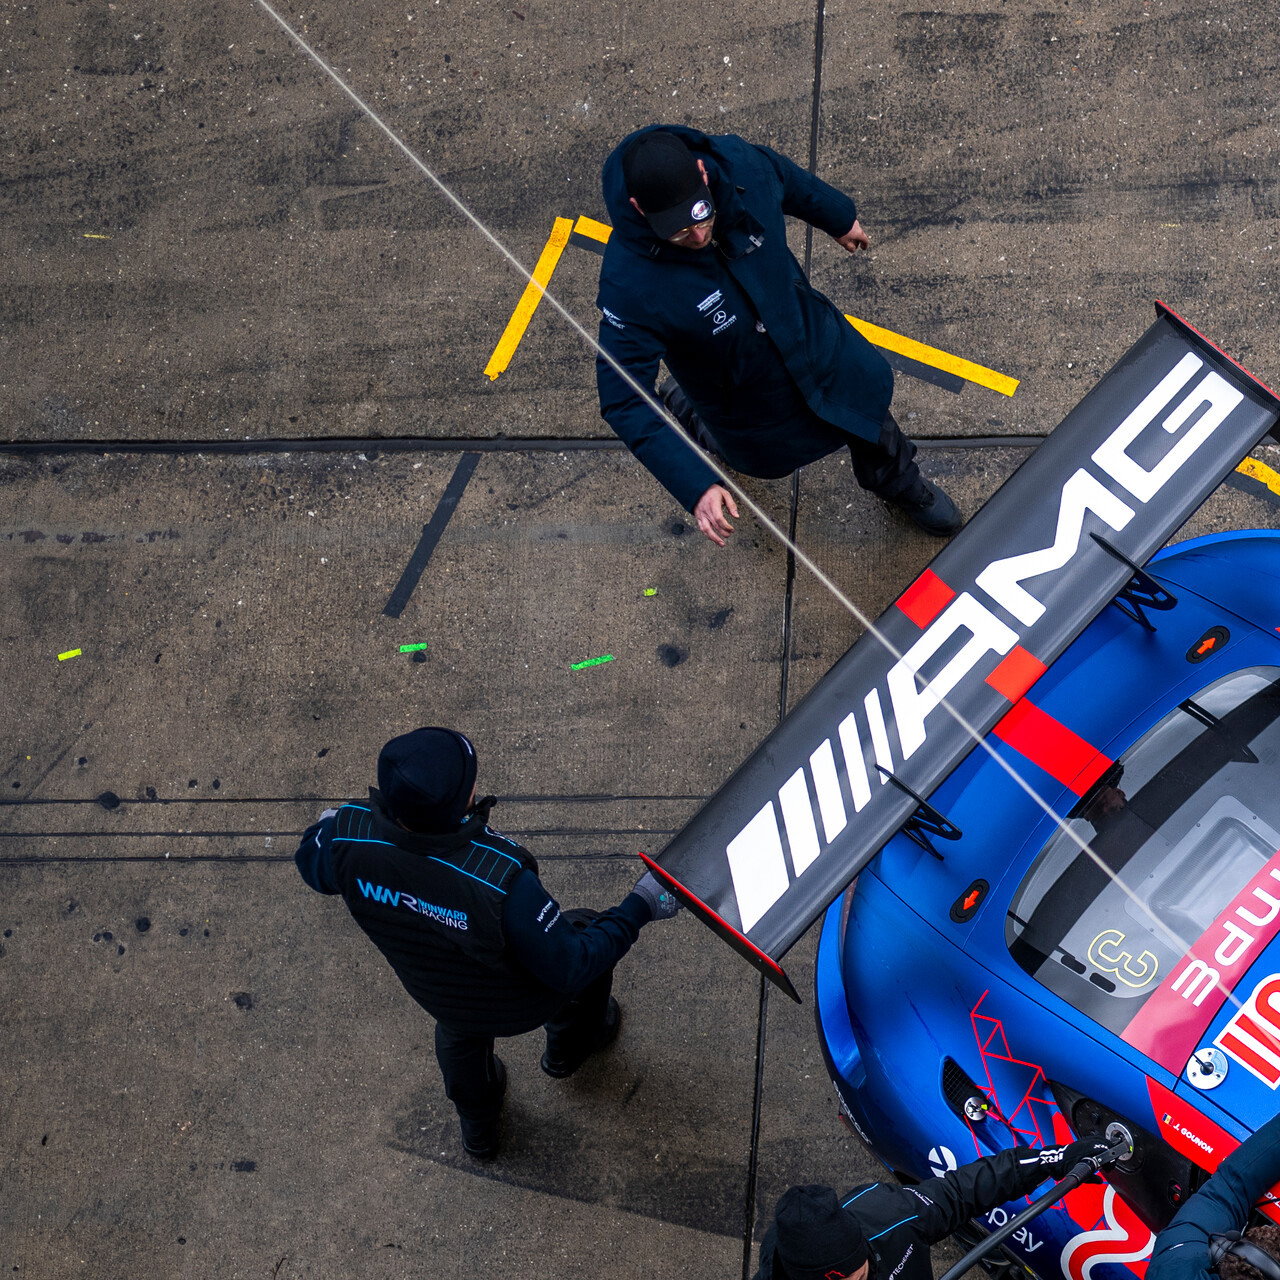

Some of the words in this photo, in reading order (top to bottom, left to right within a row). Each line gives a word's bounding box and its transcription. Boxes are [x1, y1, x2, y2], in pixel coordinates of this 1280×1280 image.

[418, 897, 468, 921] WINWARD
[421, 908, 468, 931] RACING
[1087, 929, 1158, 987] 3
[1180, 1127, 1214, 1154] GOUNON
